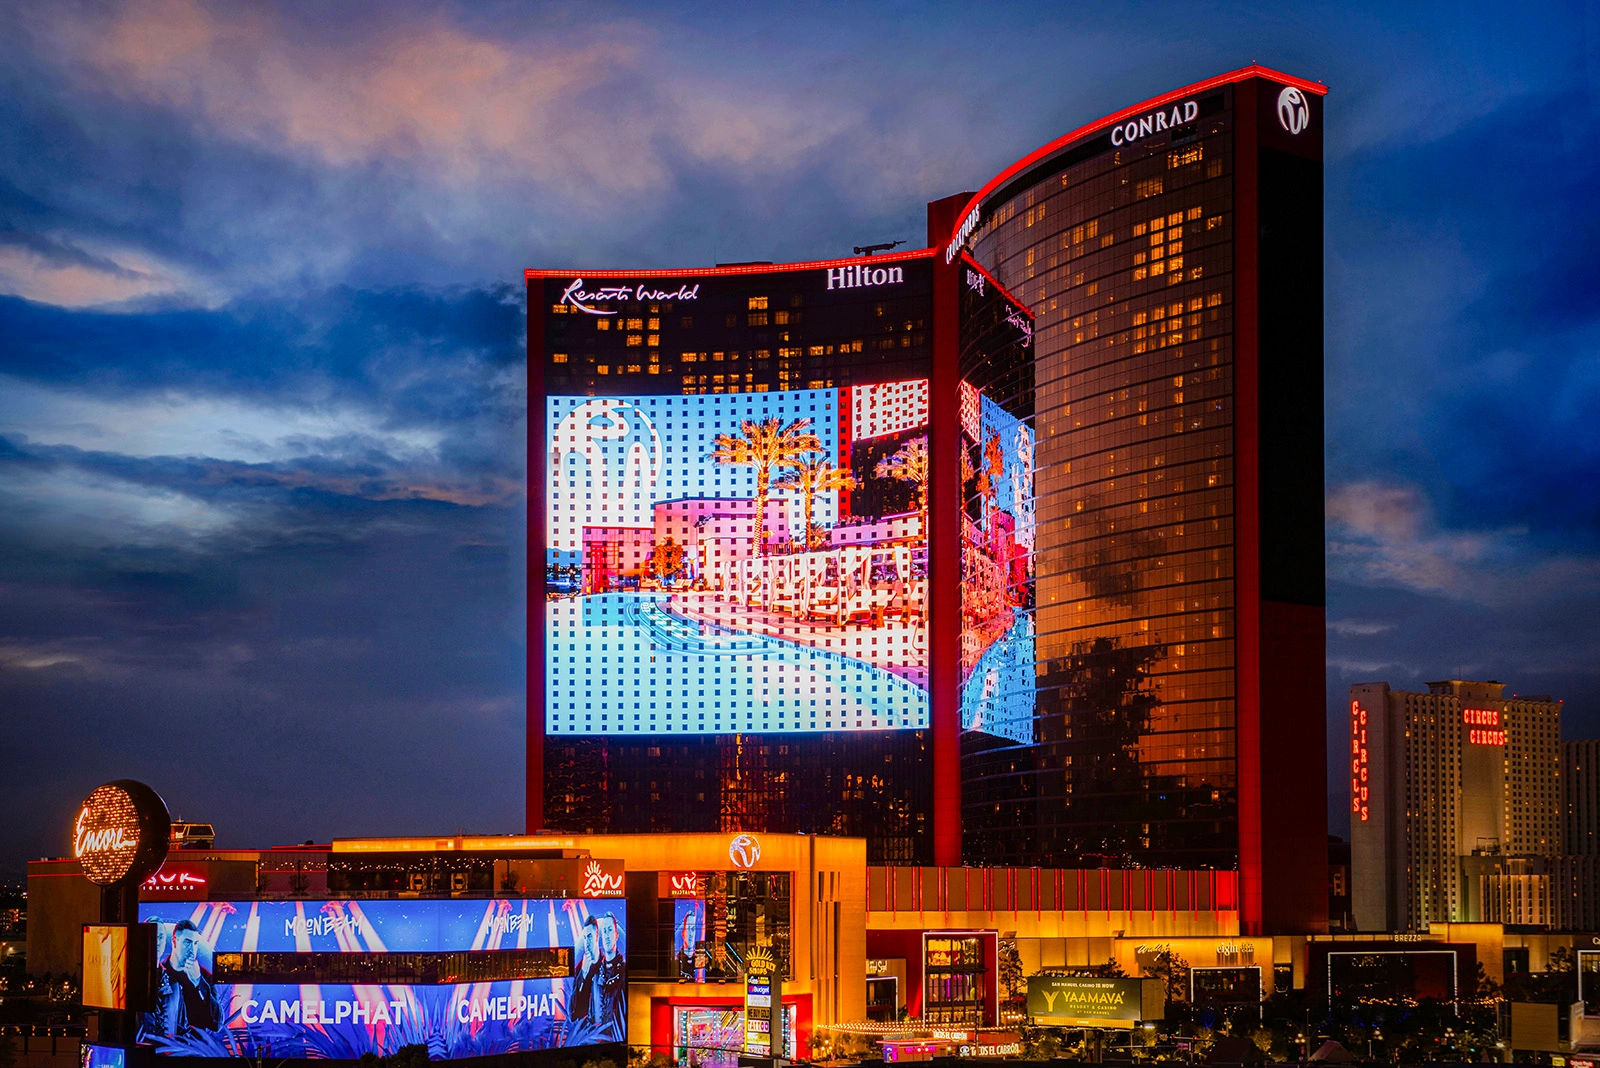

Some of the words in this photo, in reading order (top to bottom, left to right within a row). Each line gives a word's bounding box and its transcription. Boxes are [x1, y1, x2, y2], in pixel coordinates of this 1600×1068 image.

[1111, 101, 1198, 147] CONRAD
[827, 266, 903, 290] Hilton
[561, 278, 633, 314] Resorts
[636, 284, 700, 301] World
[1464, 710, 1498, 725] CIRCUS
[1470, 730, 1504, 745] CIRCUS
[1360, 710, 1368, 821] CIRCUS
[75, 808, 137, 856] Encore
[285, 915, 363, 936] MOONBEAM
[486, 913, 534, 935] MOONBEAM
[1216, 941, 1238, 956] eight
[1394, 934, 1422, 942] BREZZA
[754, 986, 770, 994] Budget
[241, 1000, 404, 1025] CAMELPHAT
[457, 993, 558, 1023] CAMELPHAT
[748, 1021, 769, 1031] TATTOO
[989, 1045, 996, 1055] EL
